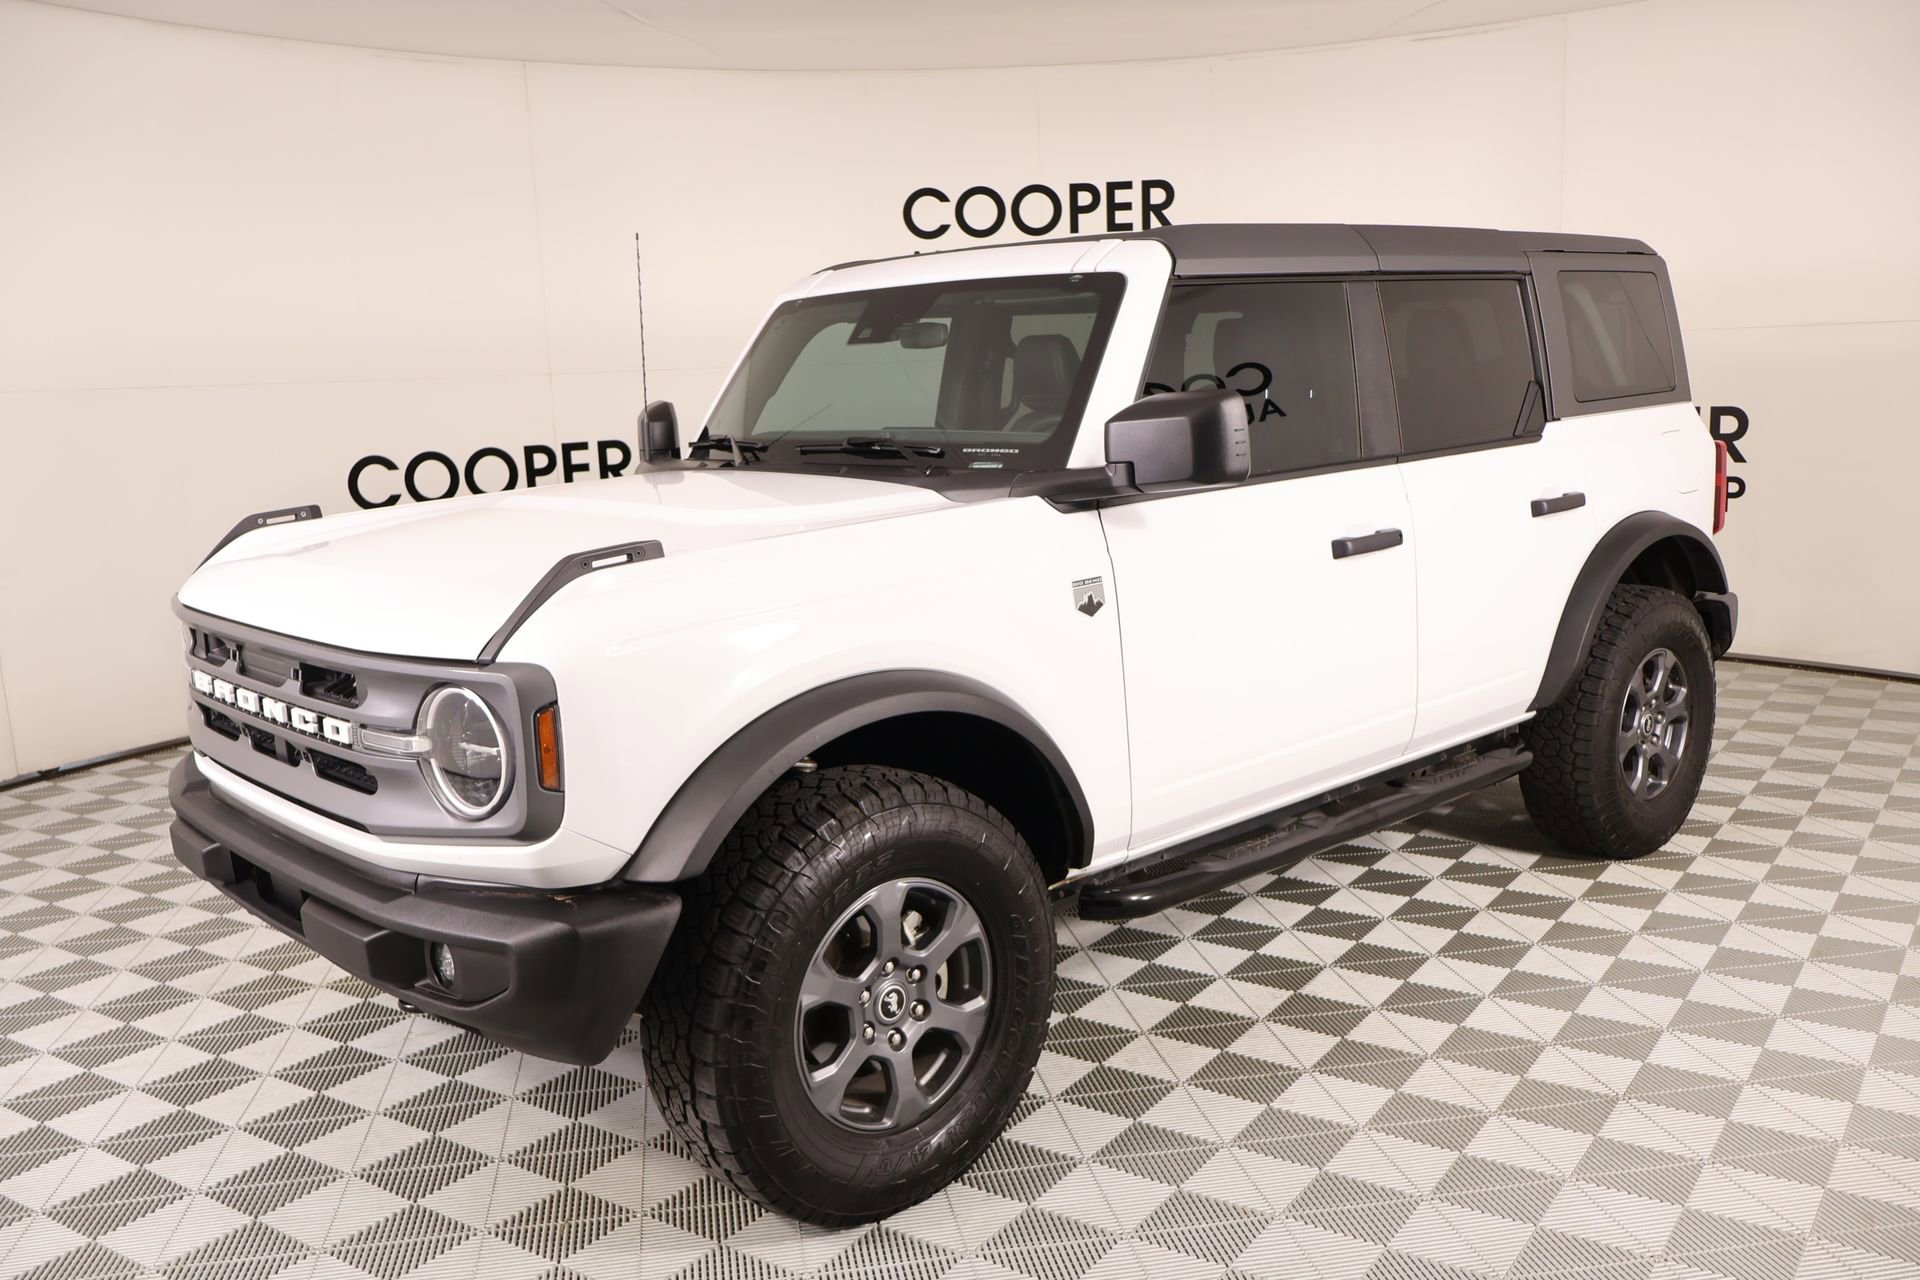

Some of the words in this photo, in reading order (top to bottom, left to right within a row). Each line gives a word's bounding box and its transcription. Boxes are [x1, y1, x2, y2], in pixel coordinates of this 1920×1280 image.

[903, 179, 1175, 240] COOPER
[347, 439, 632, 510] COOPER
[192, 669, 353, 745] BRONCO
